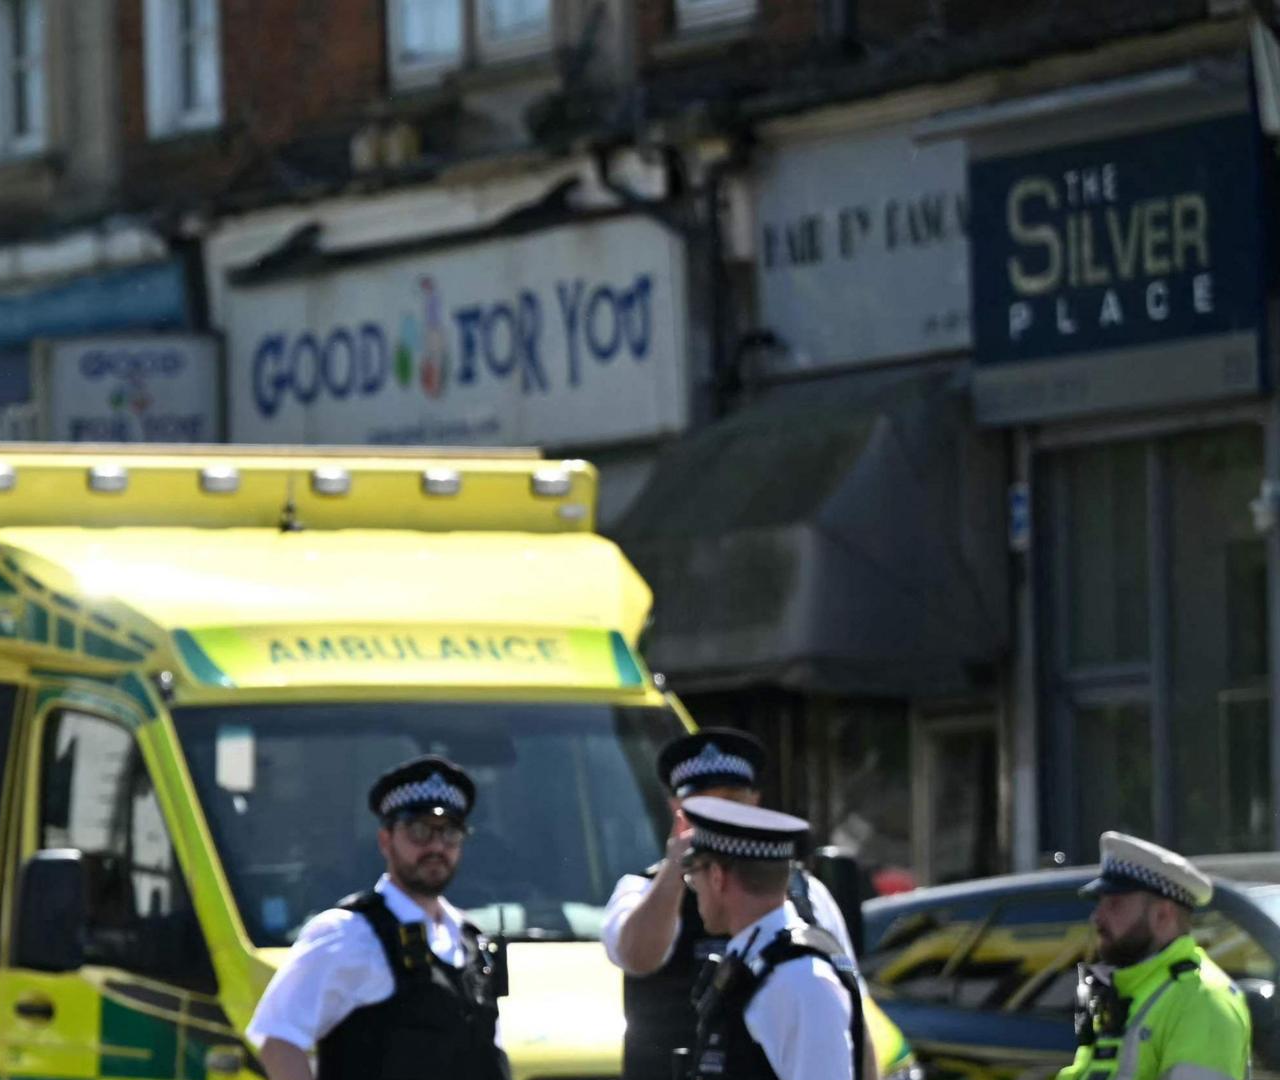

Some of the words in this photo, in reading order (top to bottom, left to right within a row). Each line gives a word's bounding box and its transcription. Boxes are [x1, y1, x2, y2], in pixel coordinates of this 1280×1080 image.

[1064, 163, 1116, 205] THE
[1007, 177, 1209, 294] SILVER
[1009, 273, 1214, 342] PLACE
[252, 321, 387, 420] GOOD
[452, 288, 550, 394] FOR
[555, 272, 654, 388] YOU
[268, 633, 568, 666] AMBULANCE
